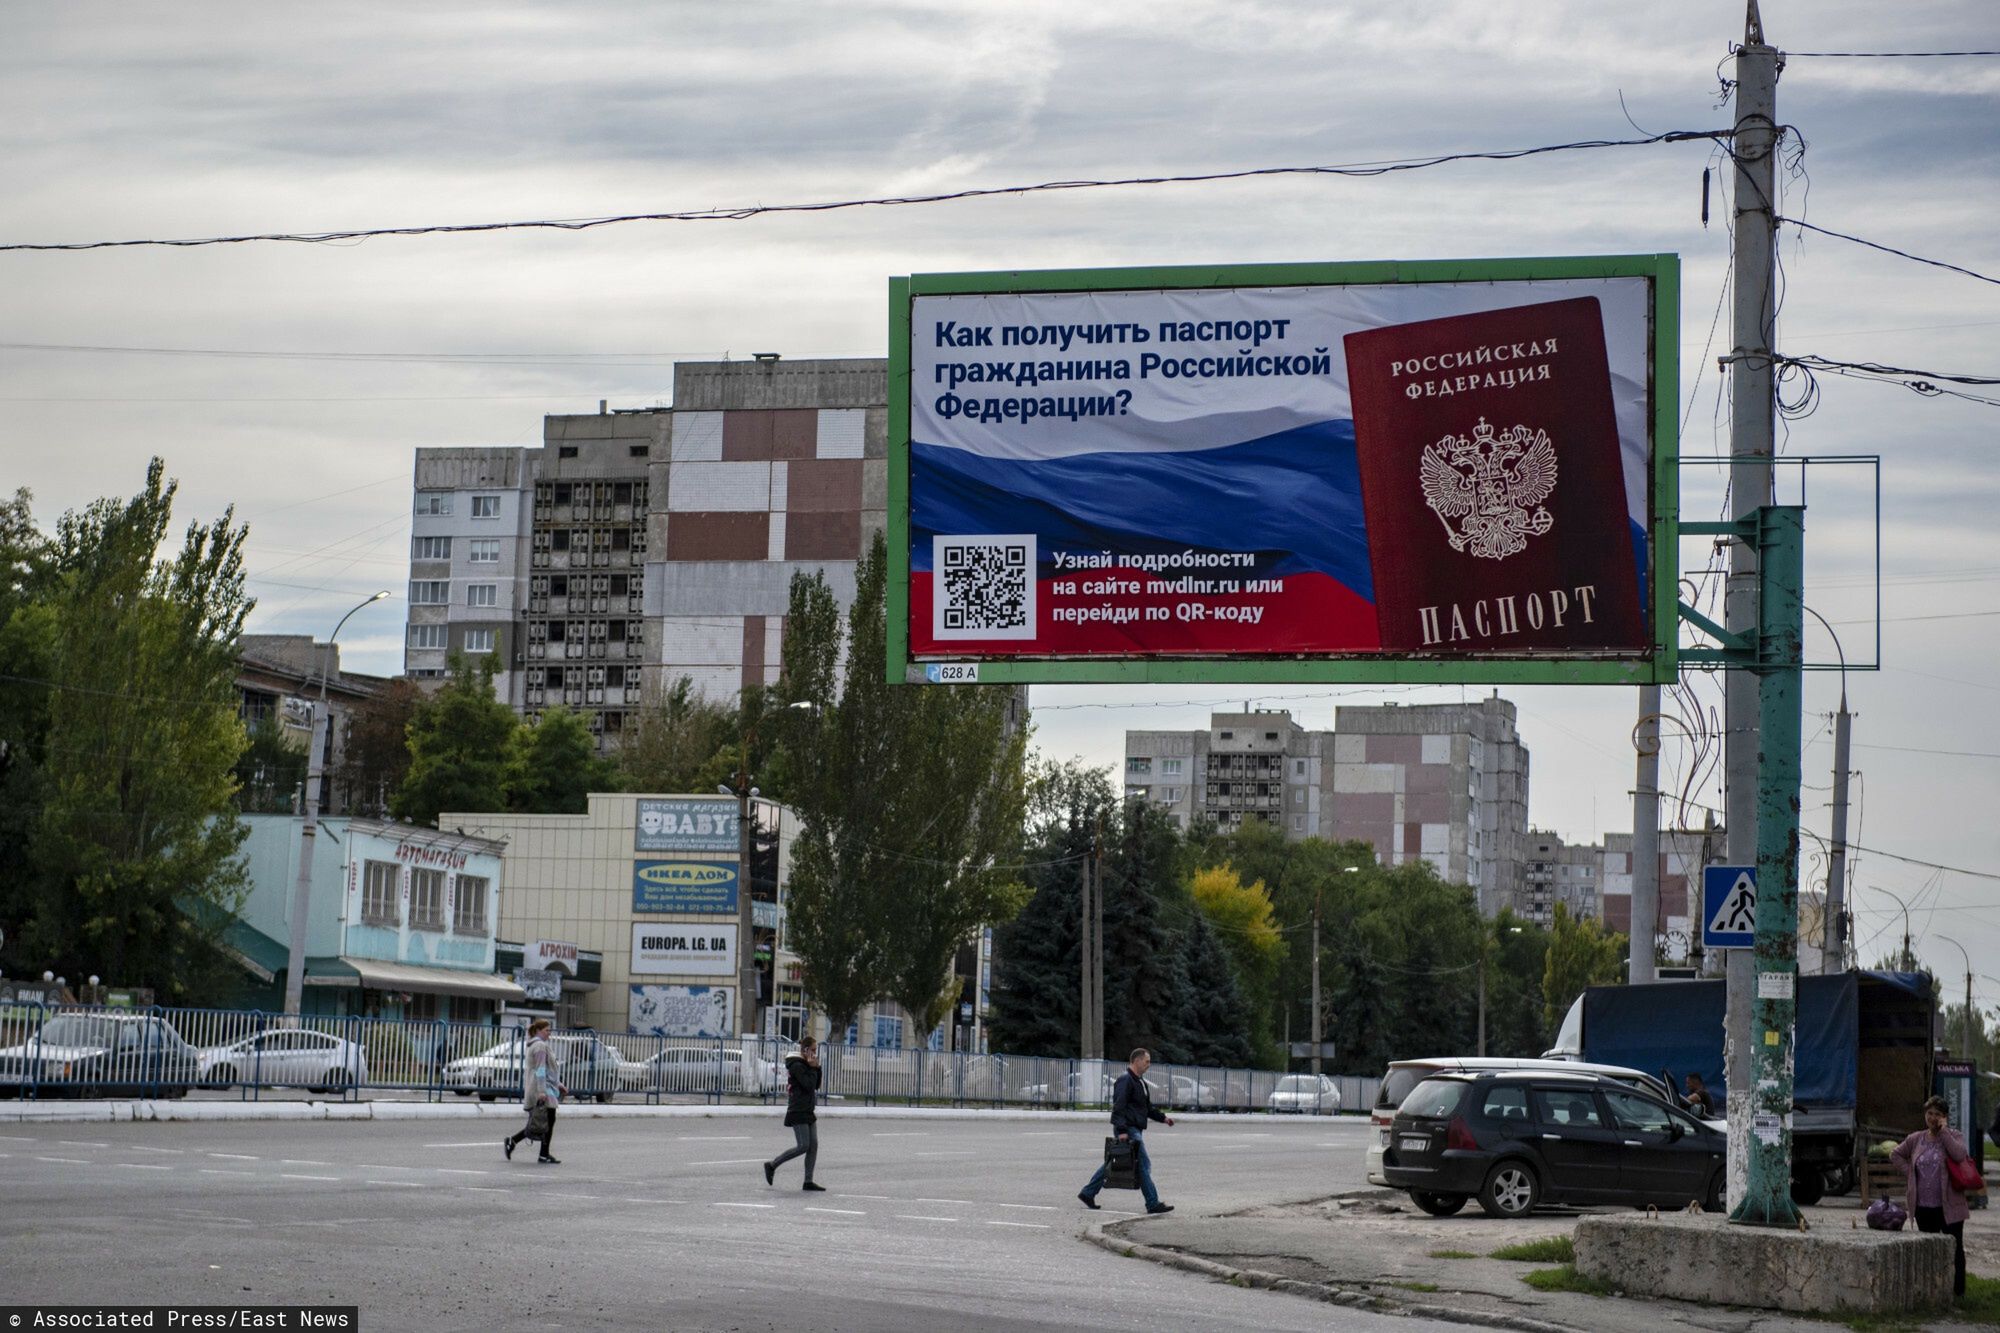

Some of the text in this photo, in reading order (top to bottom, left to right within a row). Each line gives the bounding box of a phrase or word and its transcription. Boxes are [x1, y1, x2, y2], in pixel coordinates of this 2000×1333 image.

[935, 319, 1290, 352] Как получить паспорт
[1391, 338, 1559, 376] РОССИЙСКАЯ
[935, 347, 1330, 390] гражданина Российской
[1406, 364, 1552, 400] ФЕДЕРАЦИЯ
[934, 389, 1133, 424] Федерации?
[1052, 550, 1255, 571] Узнай подробности
[1052, 576, 1284, 595] на сайте mvdlnr.ru или
[1052, 603, 1265, 625] перейди по QR-коду
[1418, 585, 1597, 645] ПАСПОРТ
[941, 667, 976, 679] 628 A
[692, 803, 738, 813] МАГАЗИН
[661, 813, 730, 835] BABY
[395, 844, 467, 870] АВТОМАГАЗИН
[694, 870, 728, 881] ДОМ
[540, 943, 578, 960] АГРОХІМ
[641, 936, 727, 951] EUROPA. LG. UA
